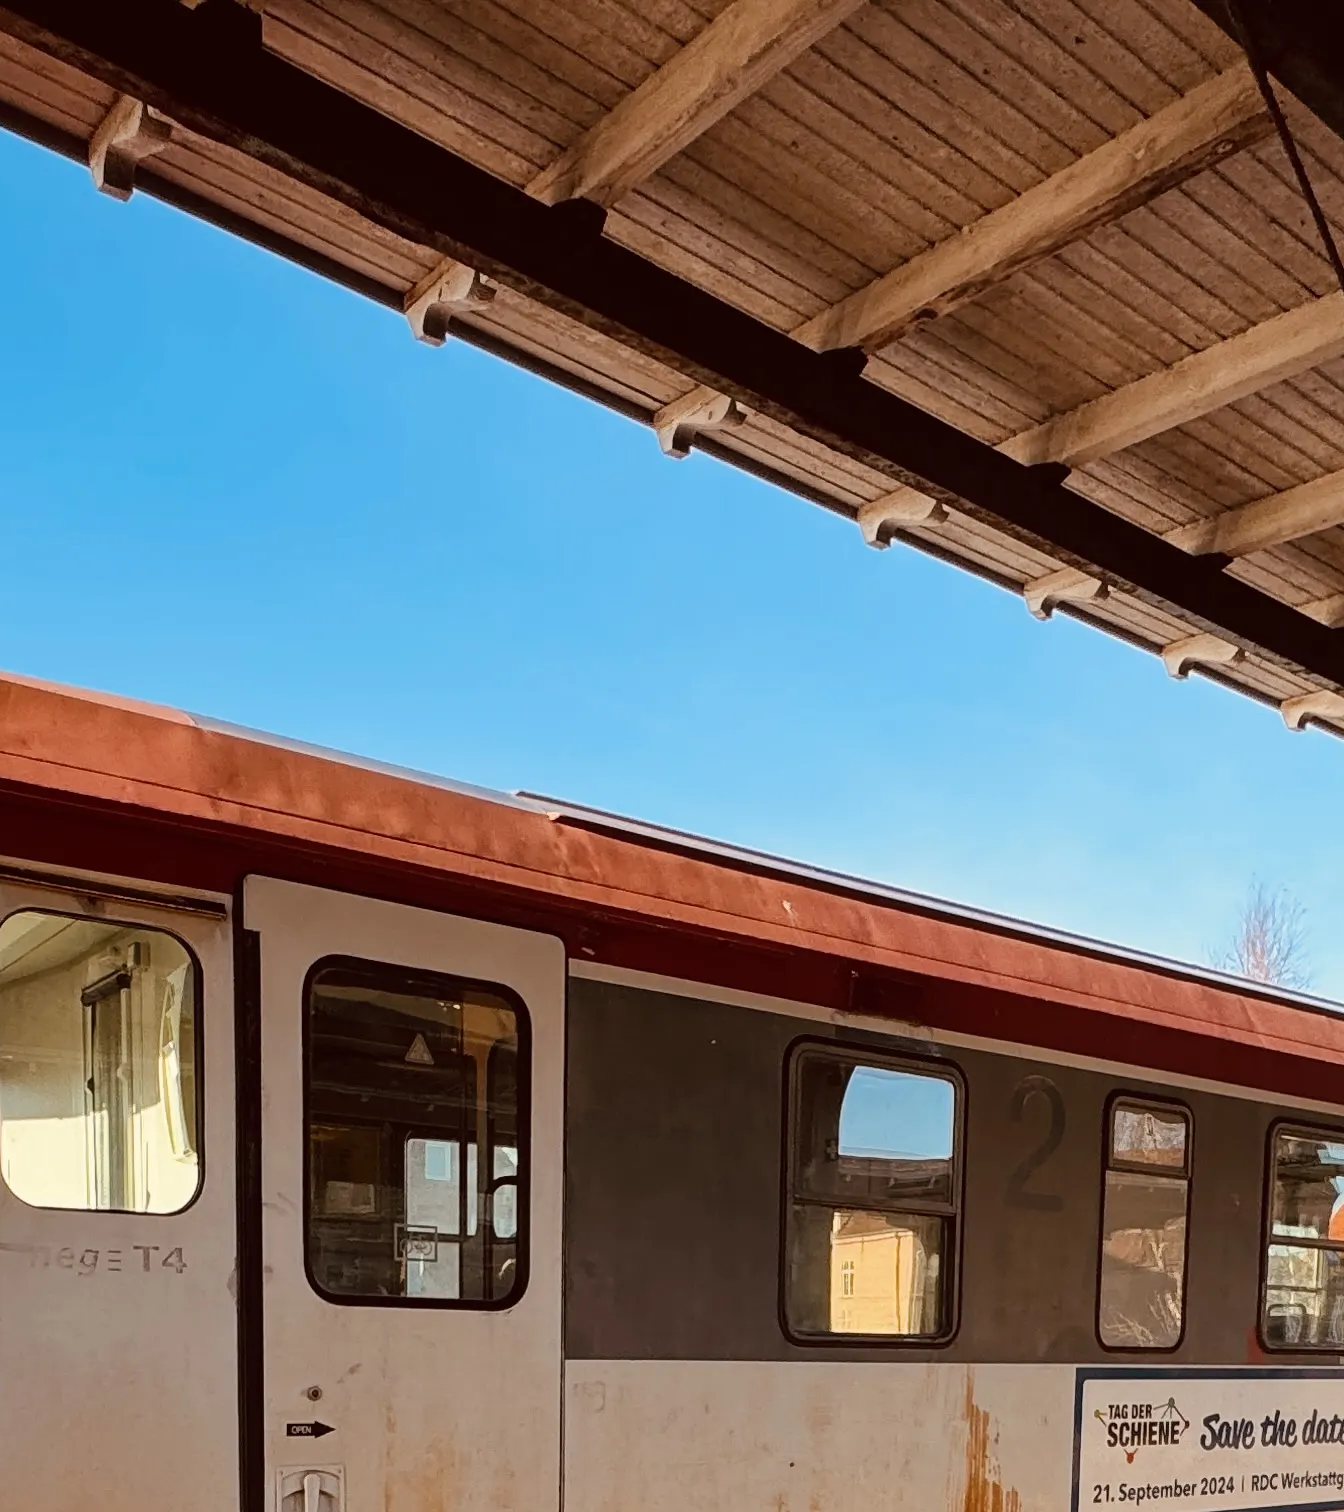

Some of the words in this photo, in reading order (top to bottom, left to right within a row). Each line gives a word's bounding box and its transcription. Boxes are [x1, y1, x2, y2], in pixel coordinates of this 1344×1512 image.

[1005, 1074, 1066, 1212] 2
[1108, 1404, 1129, 1420] TAG
[1131, 1404, 1153, 1419] DER
[291, 1426, 312, 1434] OPEN
[1107, 1421, 1181, 1447] SCHIENE
[1200, 1413, 1255, 1451] Save
[1260, 1409, 1298, 1448] the
[1093, 1484, 1115, 1503] 21.
[1118, 1479, 1197, 1506] September
[1200, 1476, 1235, 1496] 2024
[1252, 1473, 1278, 1492] RDC
